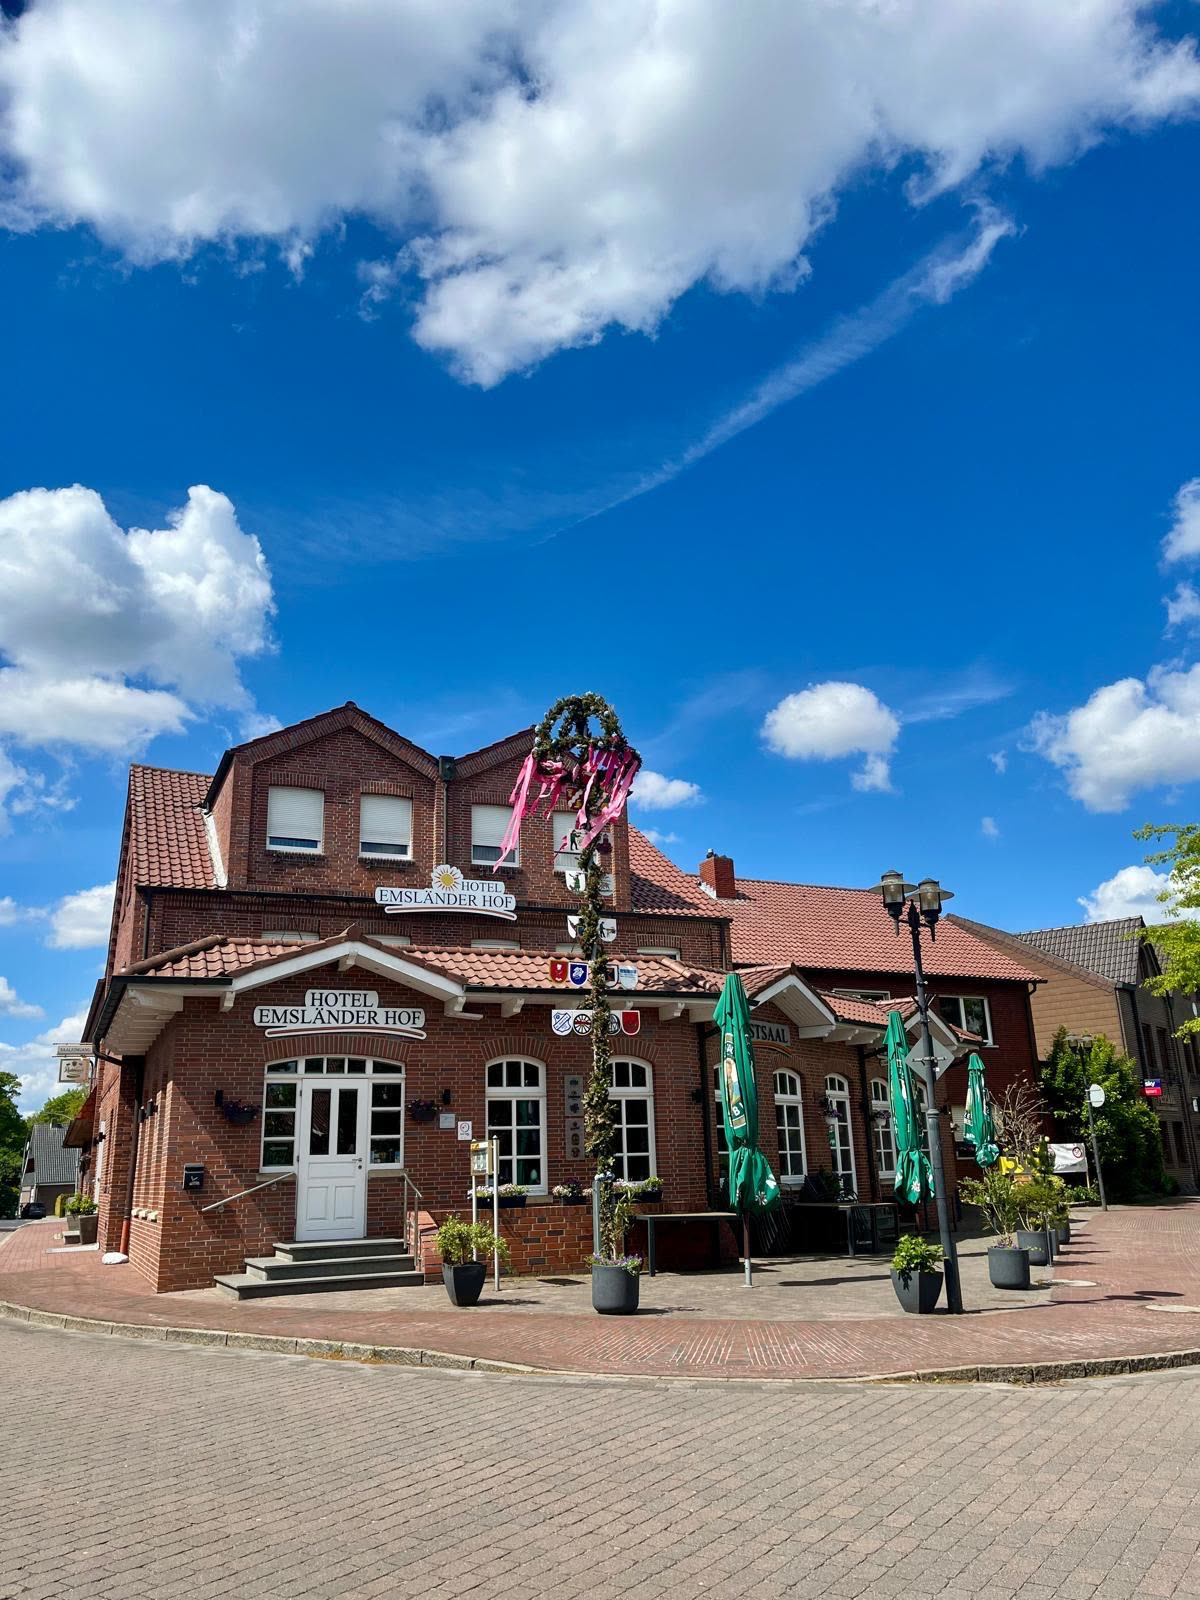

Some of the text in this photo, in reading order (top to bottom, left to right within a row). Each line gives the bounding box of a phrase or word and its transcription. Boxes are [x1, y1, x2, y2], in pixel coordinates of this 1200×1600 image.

[461, 881, 502, 893] HOTEL
[379, 889, 513, 909] EMSLÄNDER HOF
[310, 992, 374, 1008] HOTEL
[258, 1007, 422, 1026] EMSLÄNDER HOF
[749, 1024, 788, 1043] STSAAL
